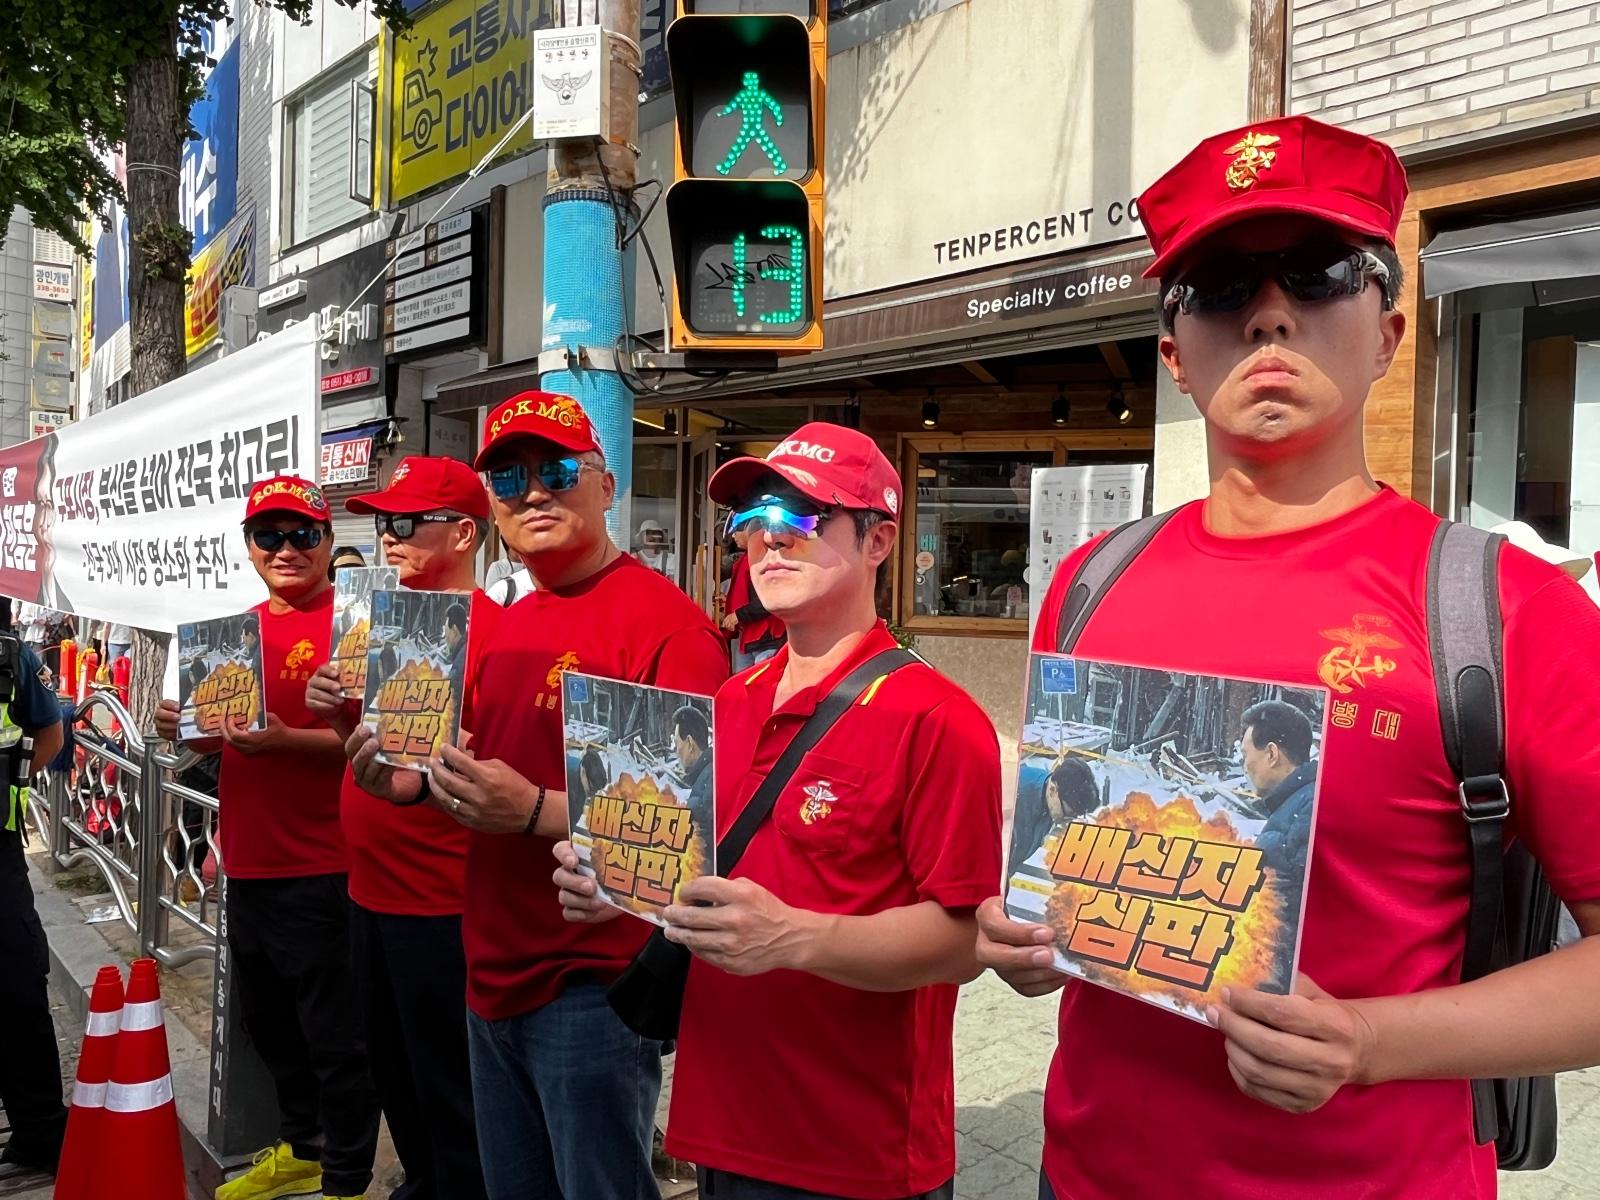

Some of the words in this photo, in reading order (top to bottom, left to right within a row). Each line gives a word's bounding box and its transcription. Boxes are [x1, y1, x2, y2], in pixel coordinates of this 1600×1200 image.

[446, 60, 534, 152] 다이어
[934, 207, 1094, 264] TENPERCENT
[966, 287, 1056, 318] Specialty
[1065, 273, 1133, 300] coffee
[99, 459, 139, 518] 부산을
[140, 450, 173, 512] 넘어
[175, 439, 214, 508] 전국
[147, 536, 191, 589] 명소화
[194, 532, 228, 590] 추진
[195, 669, 255, 706] 배신자
[203, 695, 251, 731] 심판
[378, 679, 453, 713] 배신자
[381, 713, 441, 756] 심판
[589, 795, 695, 853] 배신자
[603, 843, 682, 907] 심판
[1050, 822, 1266, 911] 배신자
[1066, 890, 1235, 992] 심판
